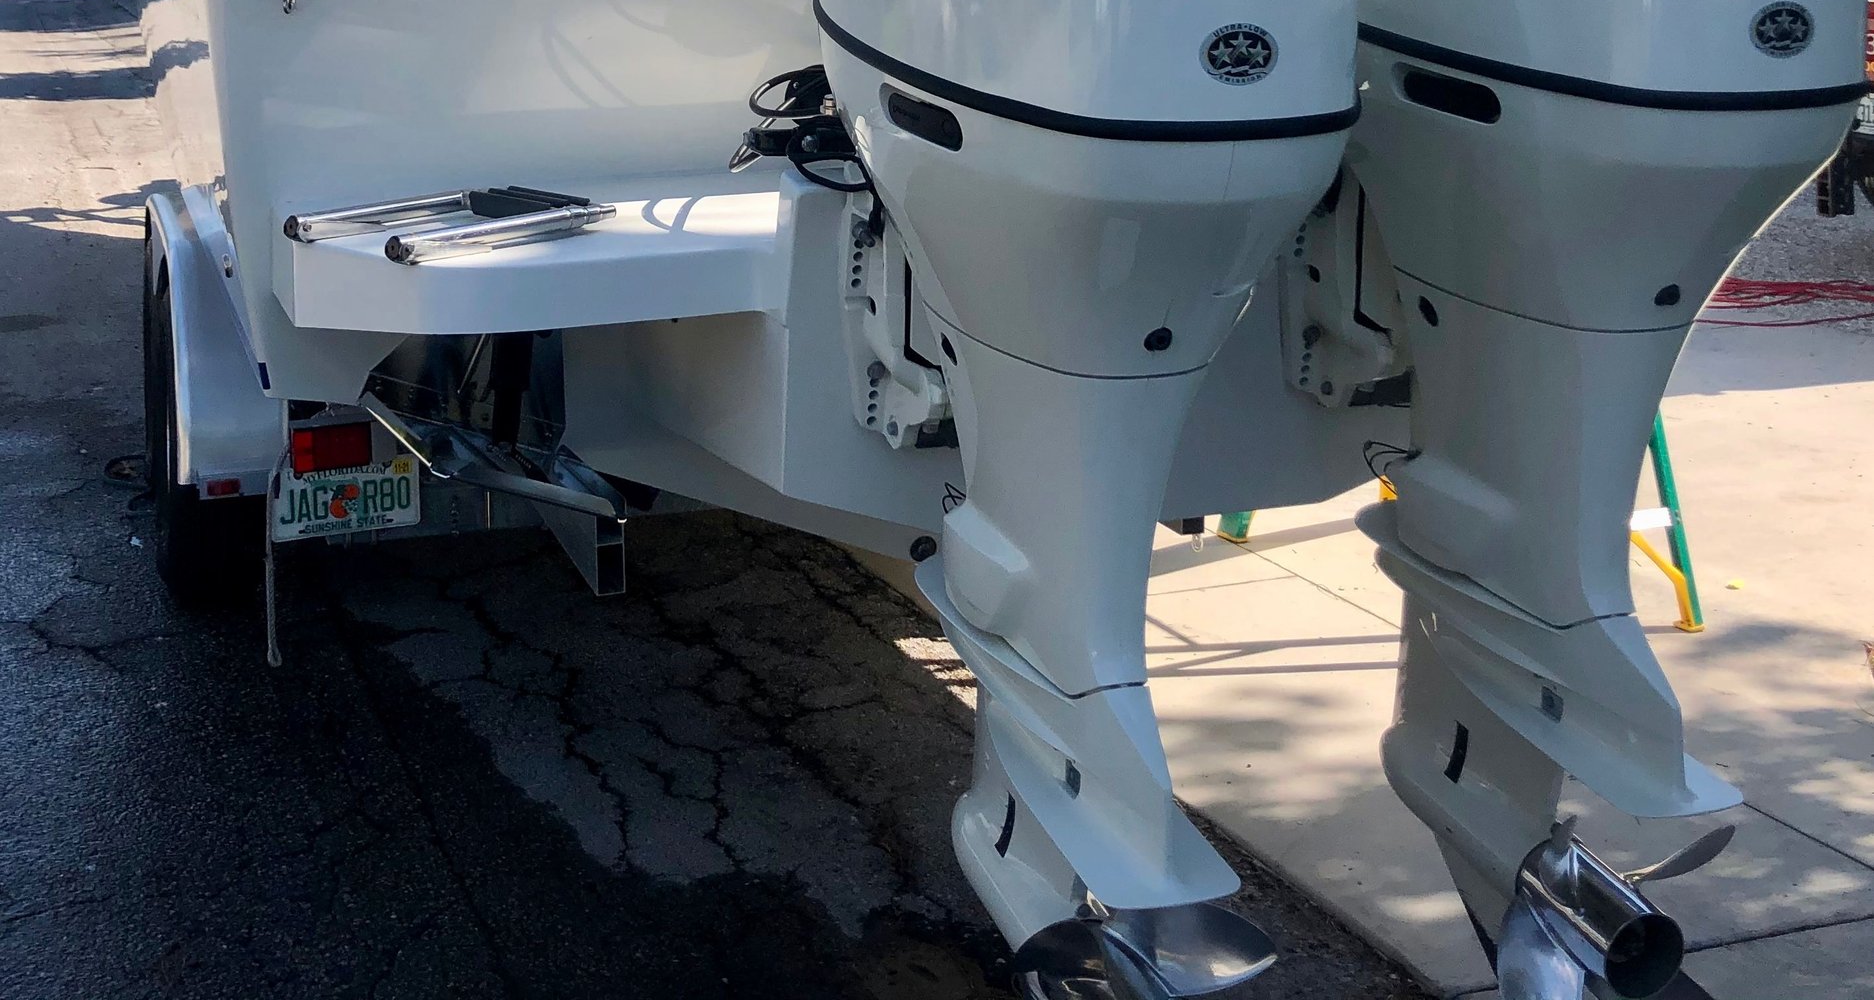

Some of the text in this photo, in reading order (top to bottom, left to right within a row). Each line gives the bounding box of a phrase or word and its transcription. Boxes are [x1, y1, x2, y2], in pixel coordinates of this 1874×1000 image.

[280, 484, 330, 525] JAG
[304, 514, 387, 534] SUNSHINE STATE
